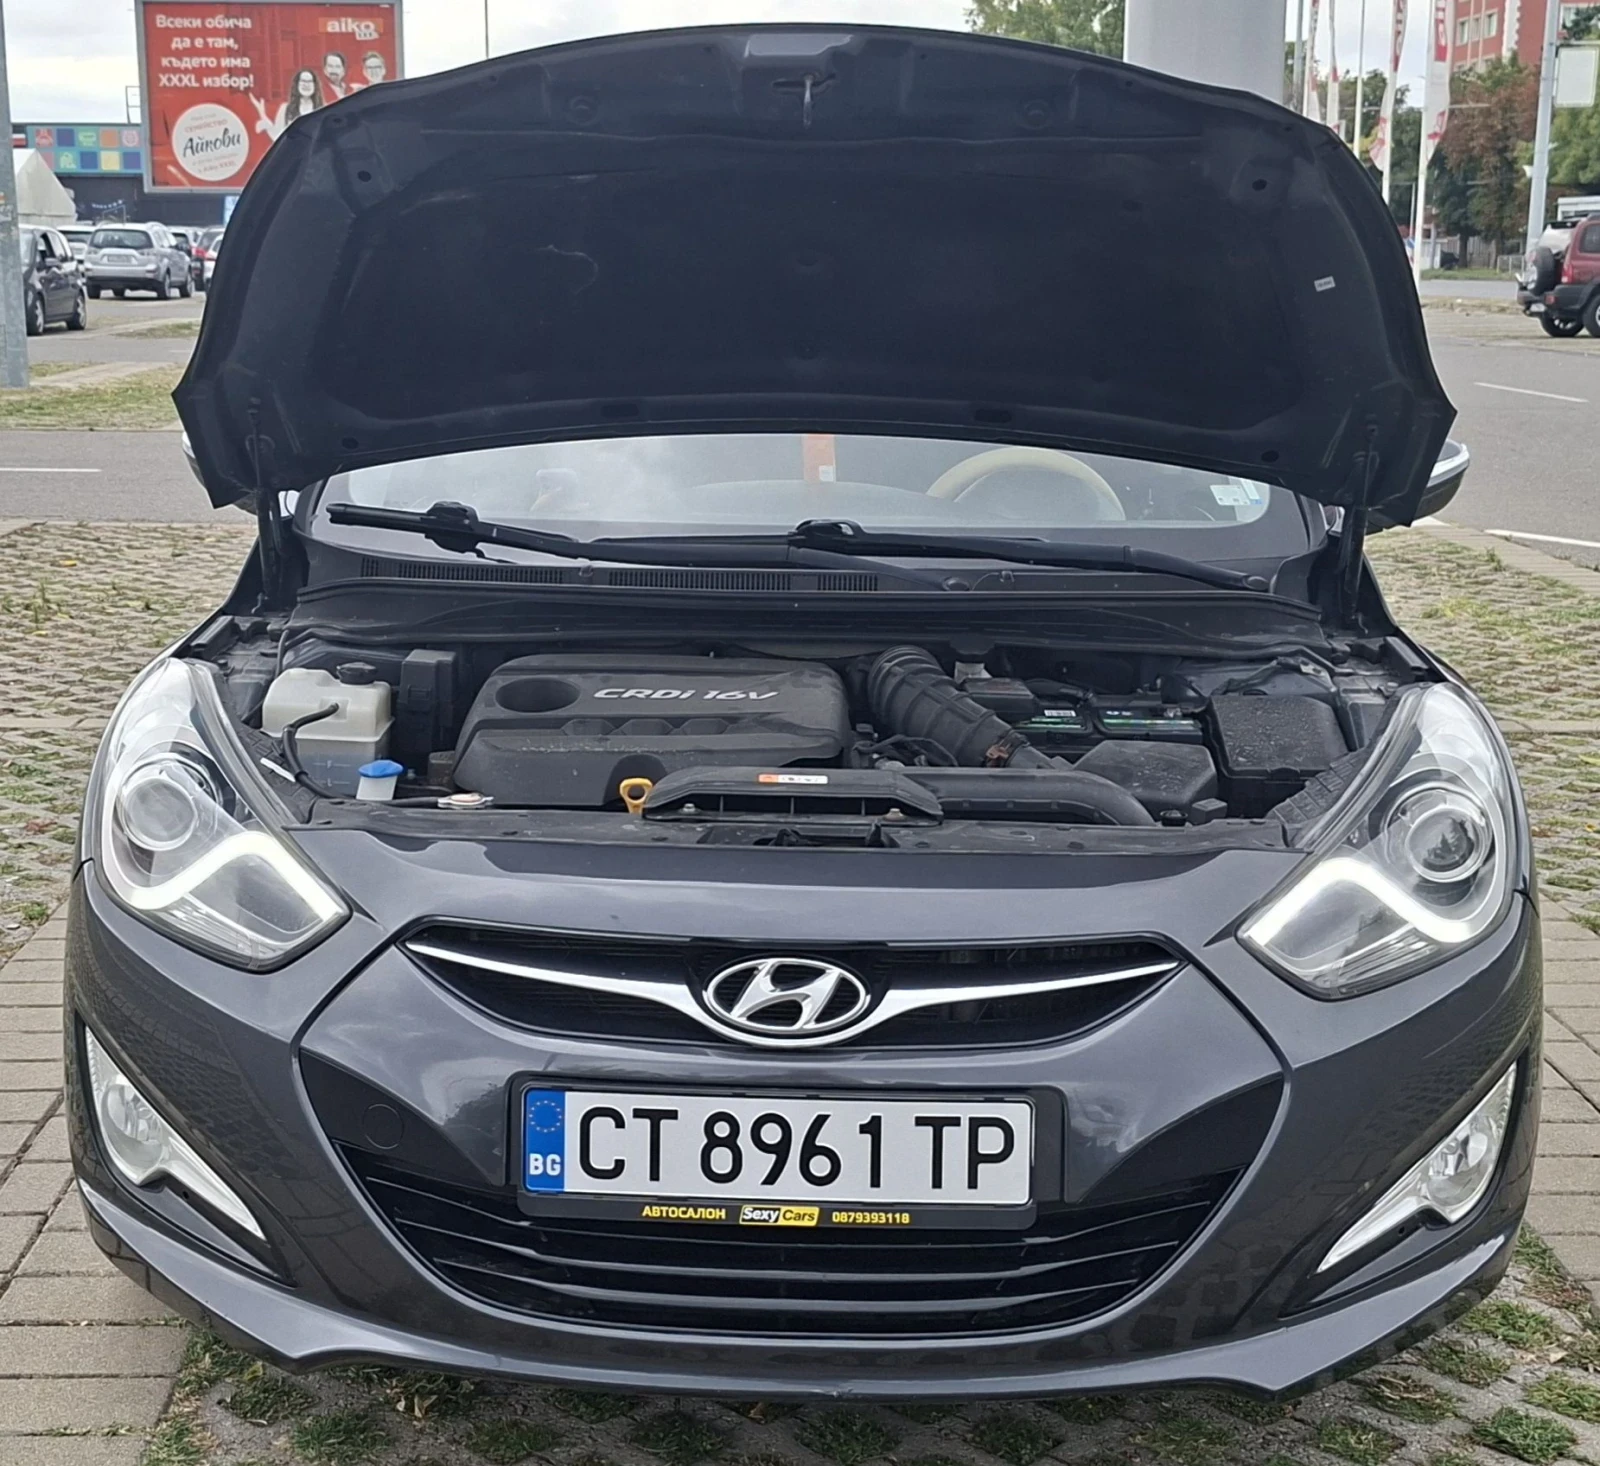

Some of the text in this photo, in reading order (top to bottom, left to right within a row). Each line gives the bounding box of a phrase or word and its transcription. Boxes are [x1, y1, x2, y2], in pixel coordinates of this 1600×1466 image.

[156, 15, 252, 29] Всеки обича
[171, 37, 239, 50] да е там,
[161, 57, 251, 70] където има
[203, 74, 254, 91] избор!
[183, 127, 241, 158] Айкови
[593, 688, 779, 700] CRDi 16V
[579, 1106, 1015, 1190] CT 8961 TP
[529, 1153, 561, 1176] BG
[642, 1205, 910, 1224] АВТОСАЛОН Sexy Cars 0879393118
